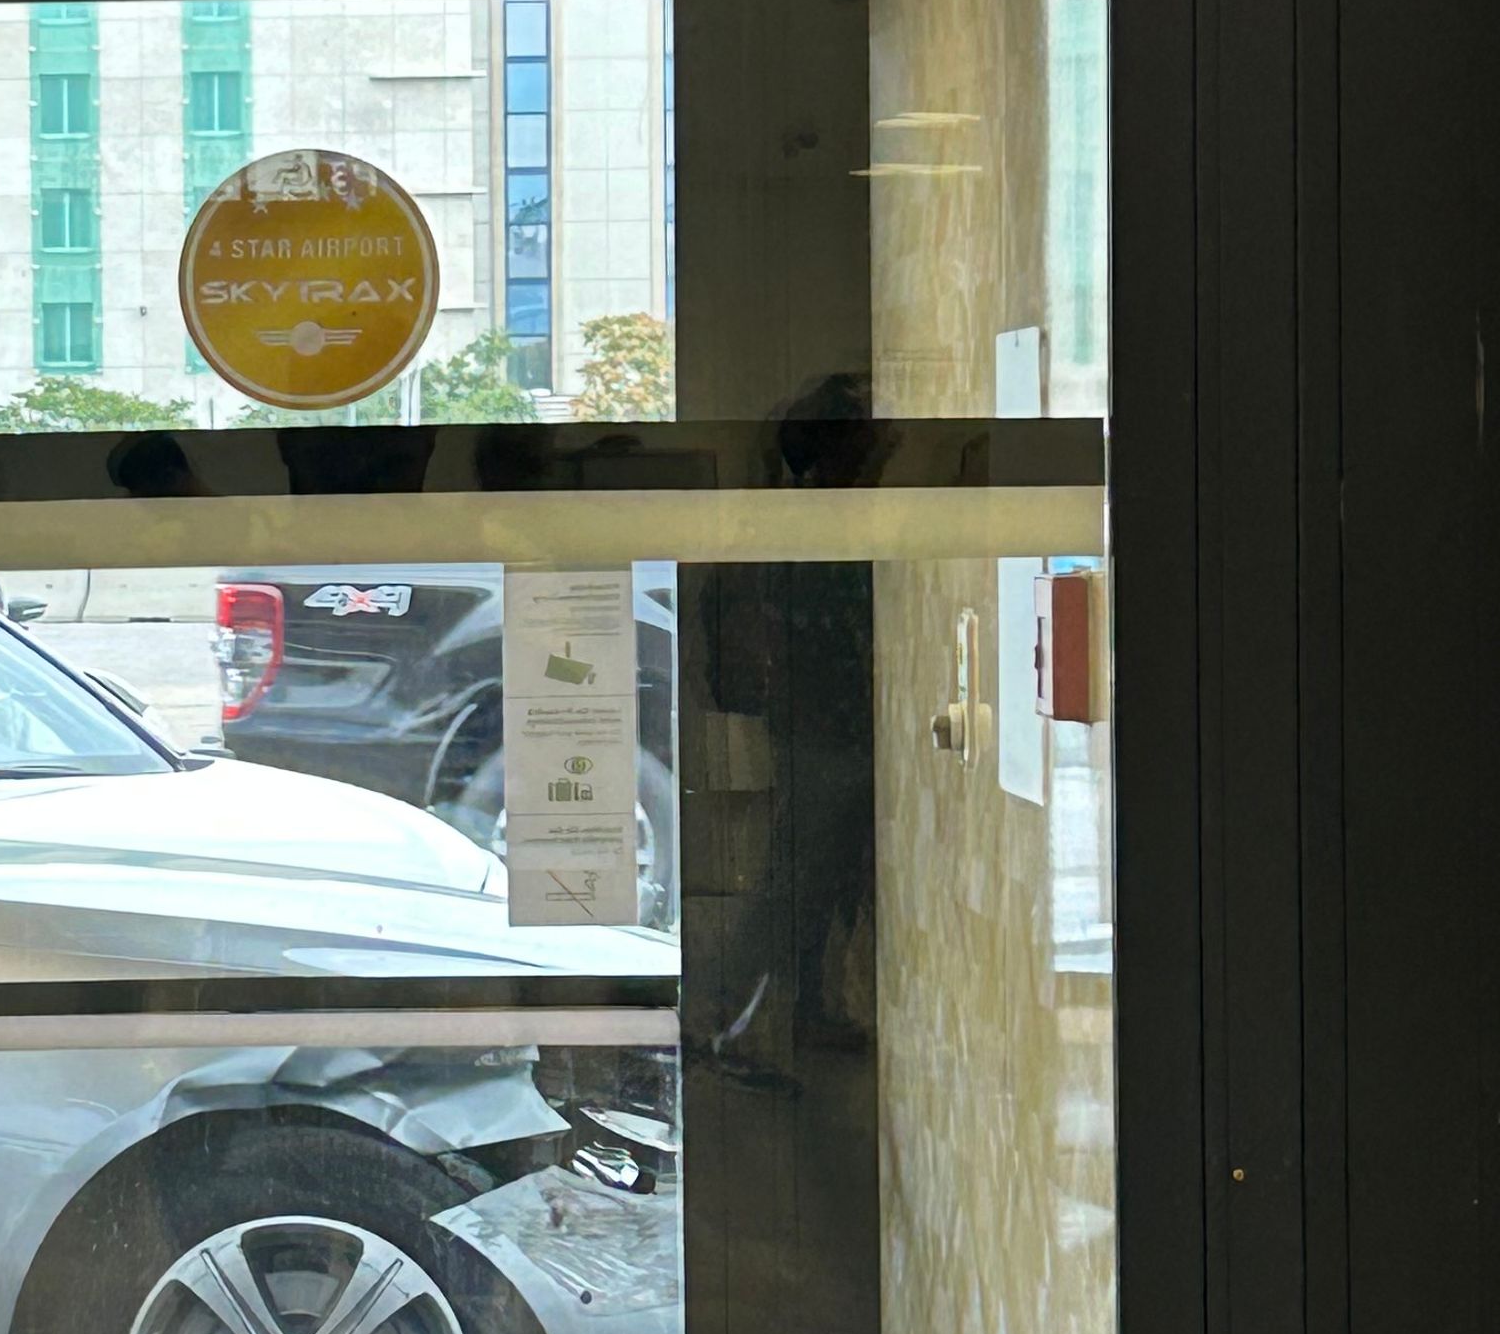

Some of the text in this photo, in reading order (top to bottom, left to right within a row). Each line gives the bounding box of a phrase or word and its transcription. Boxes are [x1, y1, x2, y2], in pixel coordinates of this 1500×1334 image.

[208, 235, 405, 259] 4 STAR AIRPORT
[200, 277, 417, 304] SKYTRAX
